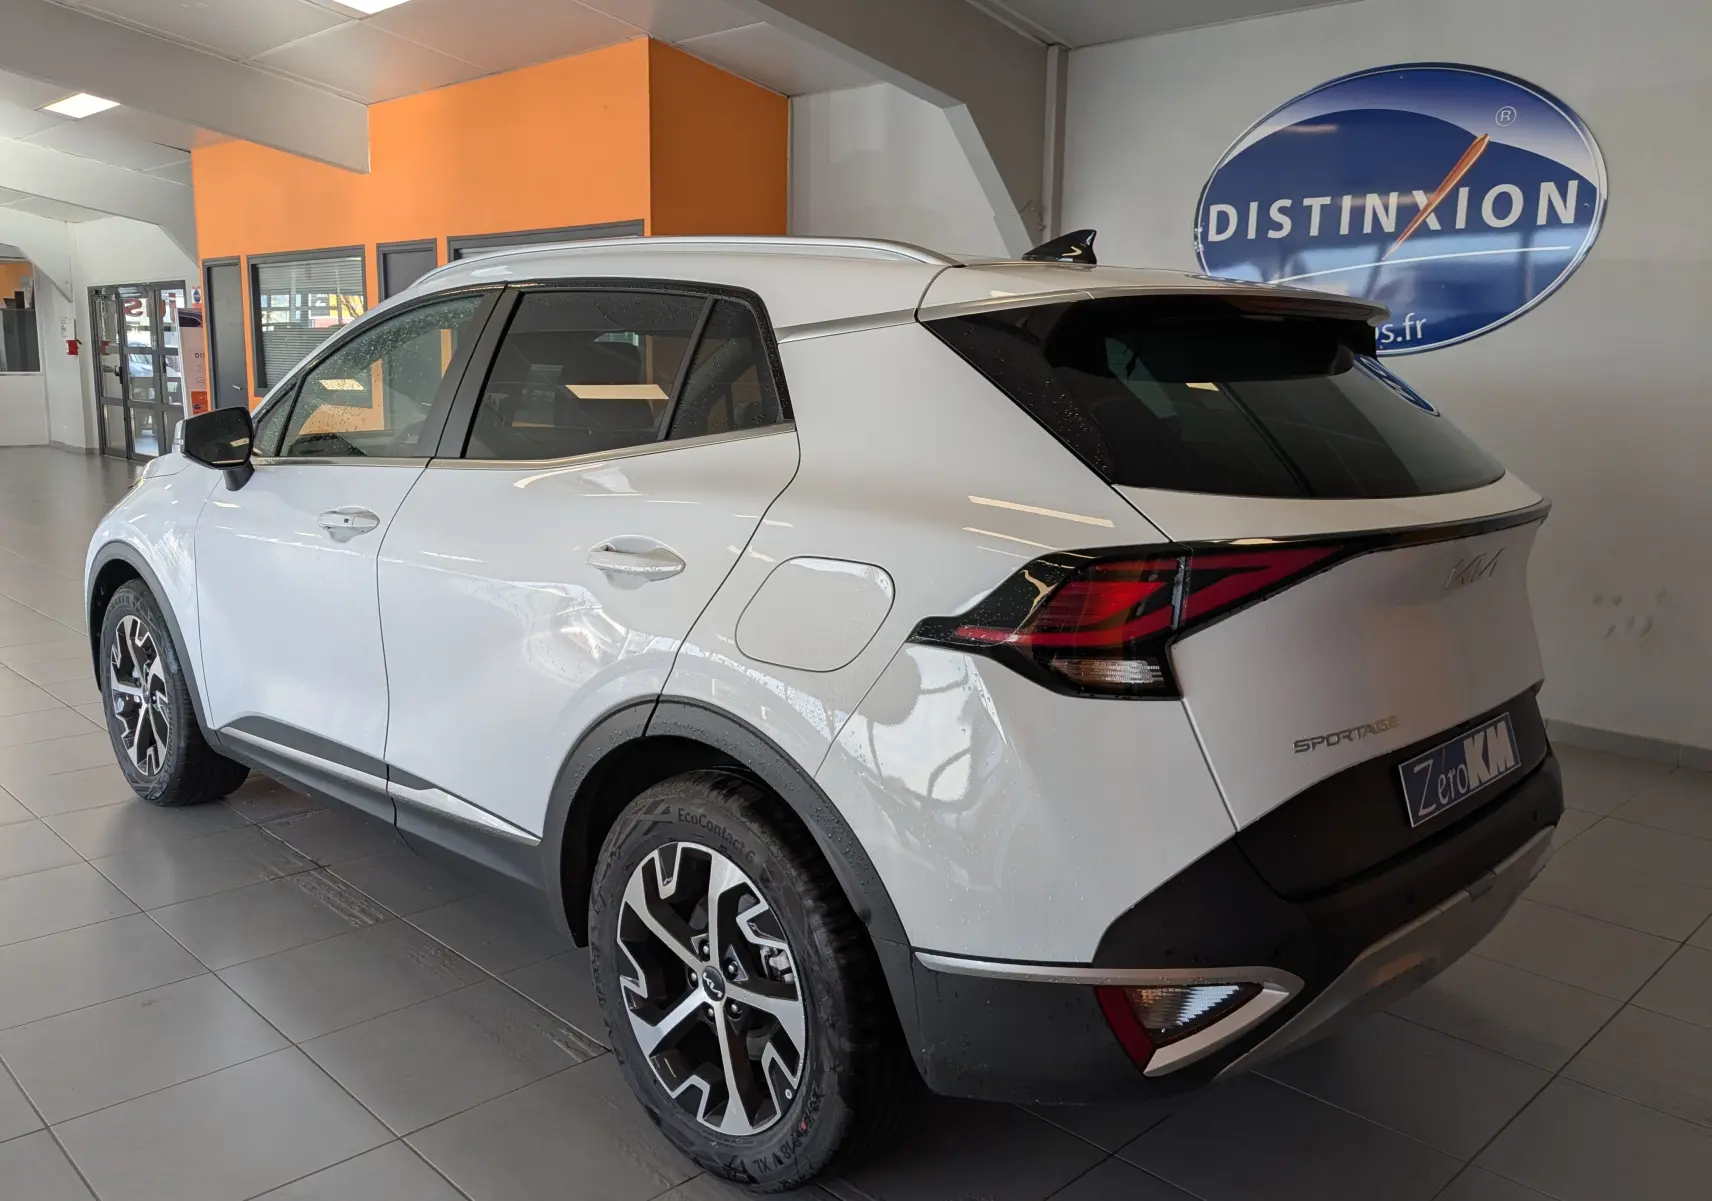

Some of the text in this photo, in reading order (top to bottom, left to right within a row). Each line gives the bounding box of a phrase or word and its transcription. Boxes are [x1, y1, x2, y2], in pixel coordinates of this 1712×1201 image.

[1207, 178, 1579, 243] DISTINXION
[1375, 312, 1427, 343] s.fr
[1292, 714, 1398, 753] SPORTAGE
[677, 807, 756, 864] EcoContact 6
